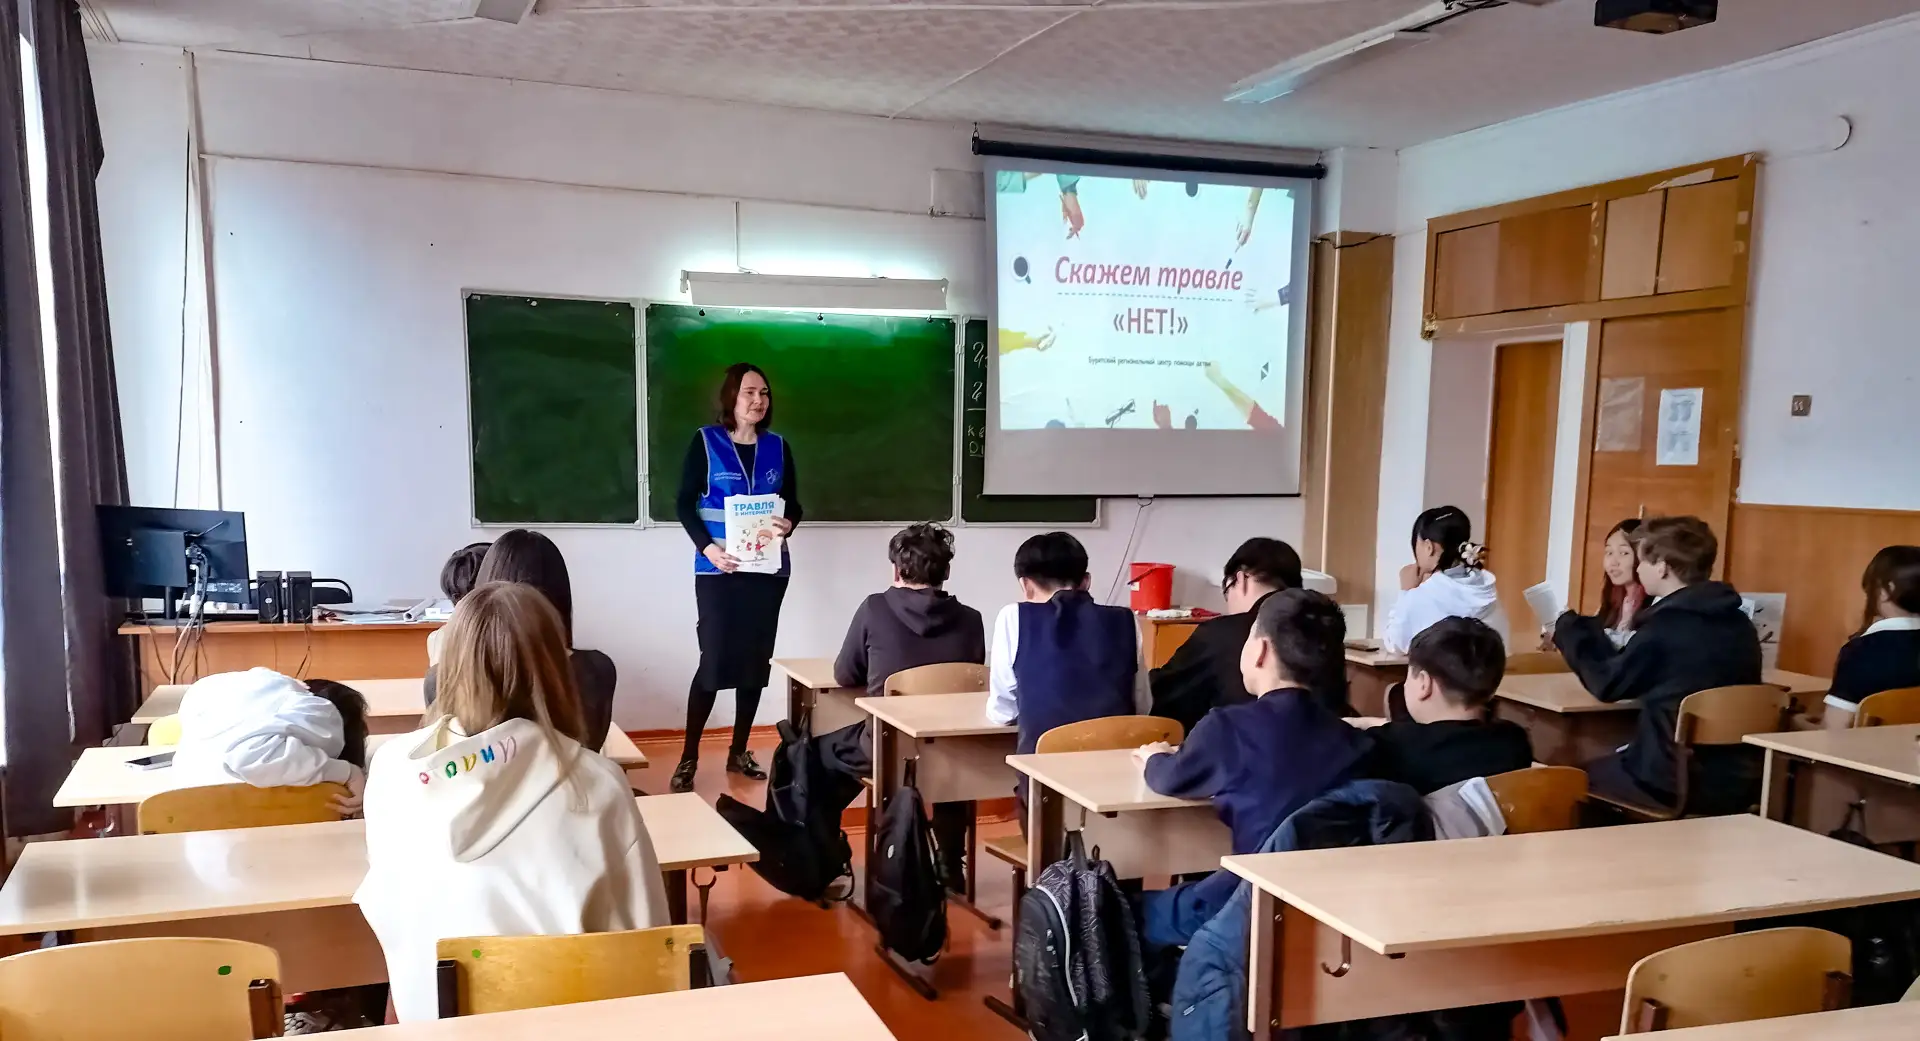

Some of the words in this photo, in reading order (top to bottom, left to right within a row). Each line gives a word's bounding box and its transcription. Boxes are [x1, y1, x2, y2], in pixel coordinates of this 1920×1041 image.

[1055, 256, 1150, 286] Скажем
[1113, 307, 1189, 335] «НЕТ!»
[733, 501, 775, 511] ТРАВЛЯ
